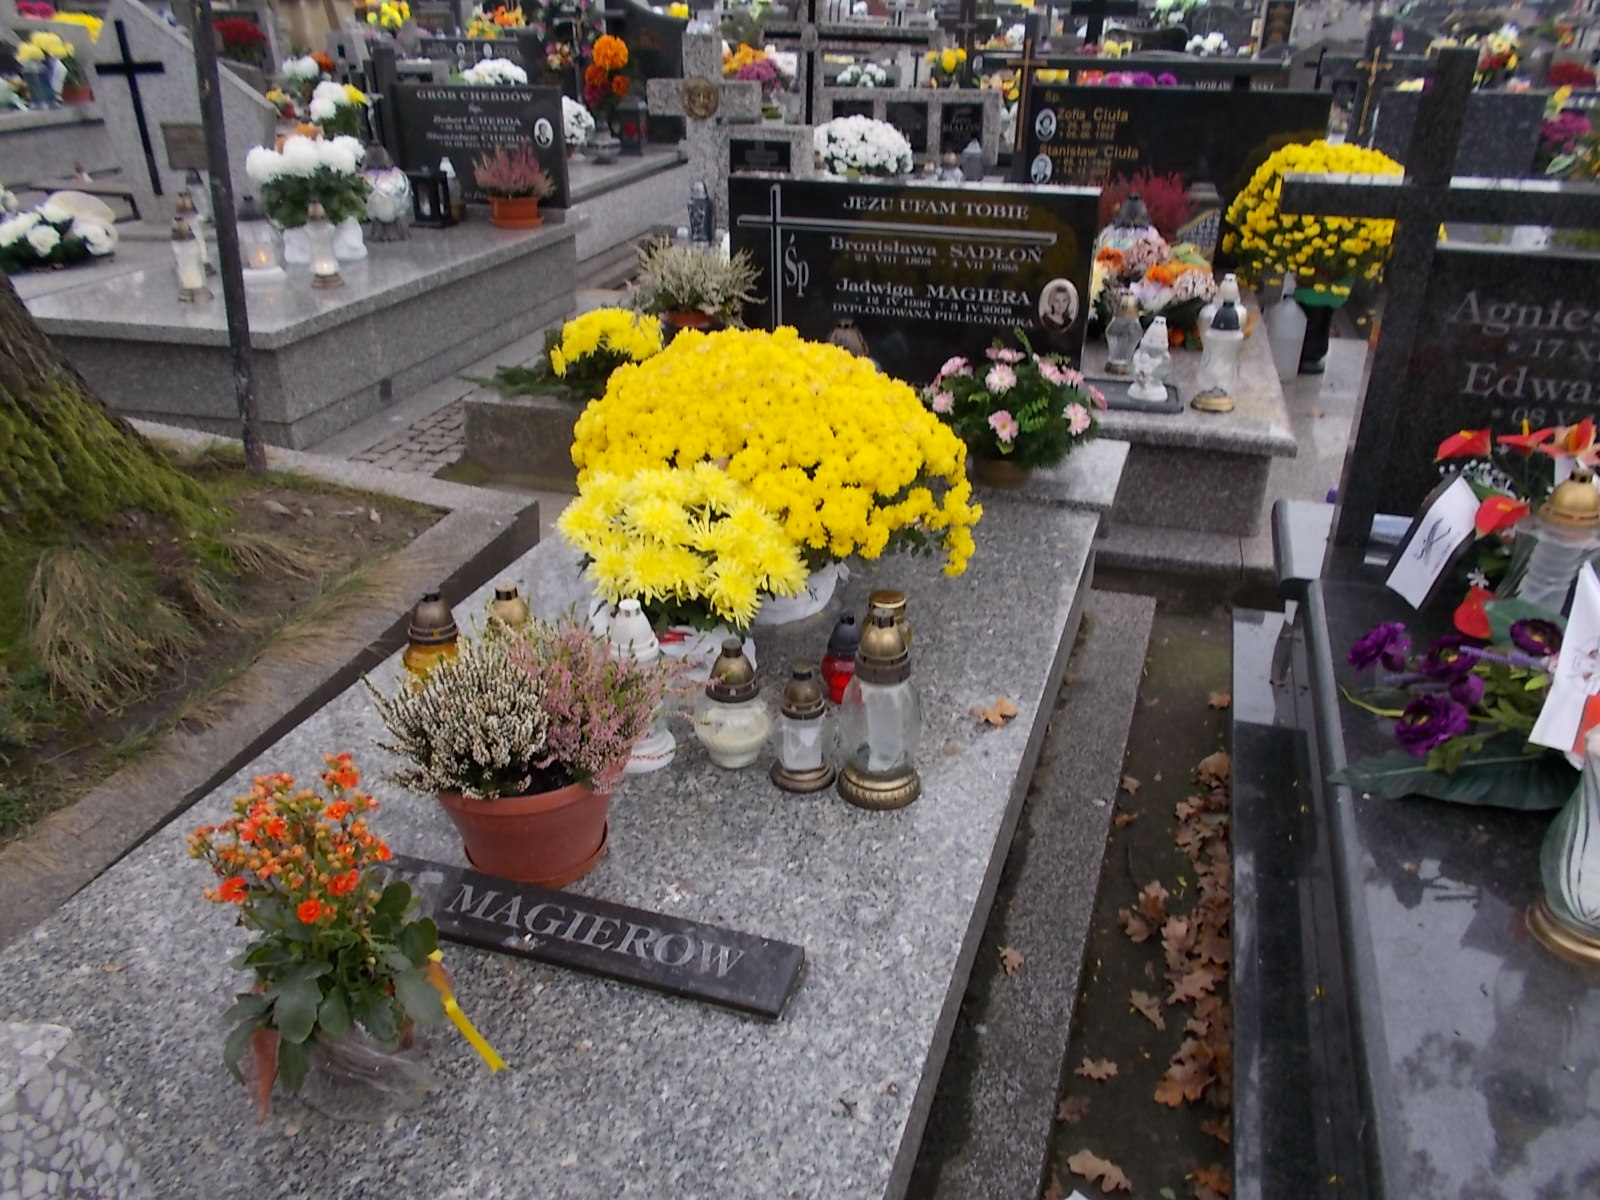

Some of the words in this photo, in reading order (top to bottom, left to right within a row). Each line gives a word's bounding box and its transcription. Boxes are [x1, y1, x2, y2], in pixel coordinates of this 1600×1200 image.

[1056, 107, 1086, 120] Zofia
[843, 195, 894, 211] JEZU
[900, 199, 956, 215] UFAM
[963, 201, 1030, 220] TOBIE
[830, 236, 938, 257] Bronisława
[875, 254, 897, 265] VIII
[965, 261, 983, 270] VII
[836, 278, 914, 299] Jadwiga
[926, 283, 1032, 307] MAGIERA
[832, 302, 931, 320] DYPLOMOWANA
[966, 303, 980, 313] IV
